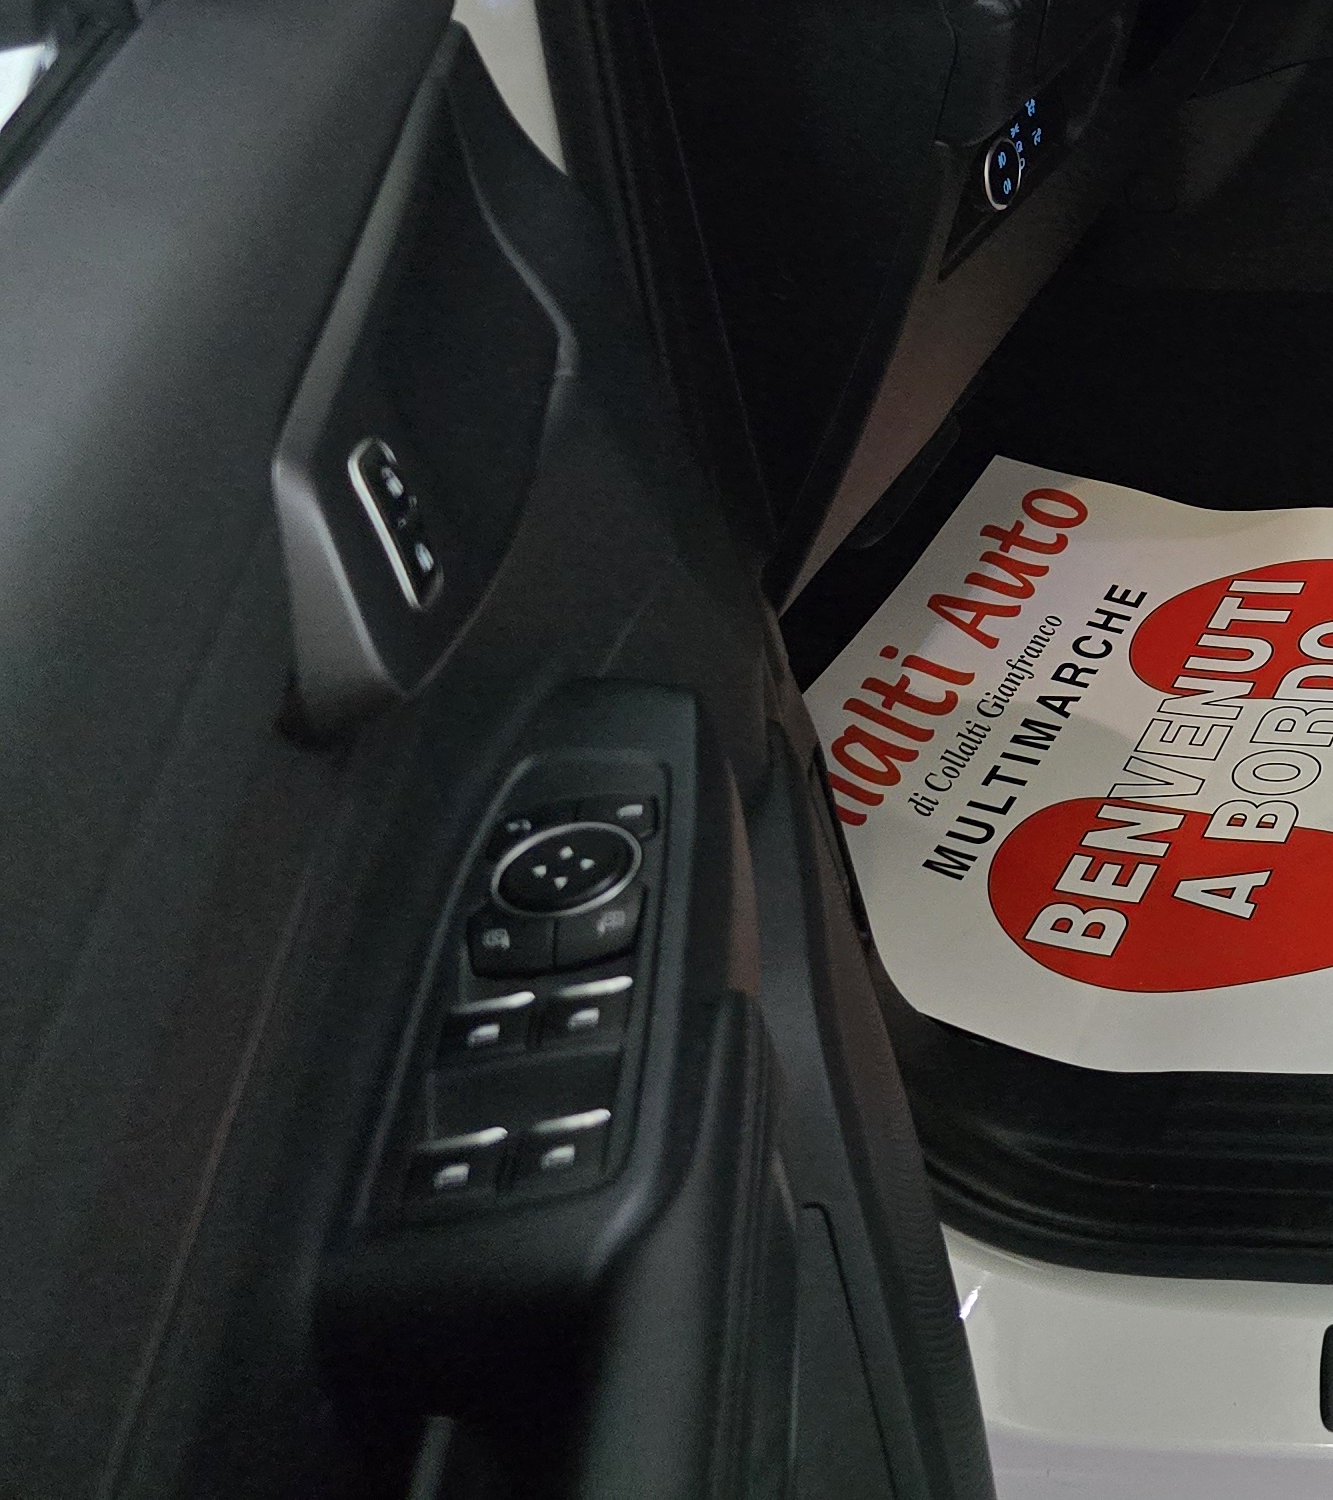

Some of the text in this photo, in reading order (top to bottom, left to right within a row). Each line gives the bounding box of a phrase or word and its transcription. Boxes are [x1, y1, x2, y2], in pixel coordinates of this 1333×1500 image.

[926, 487, 1089, 650] Auto
[907, 615, 1063, 817] di Collalti Gianfranco
[921, 583, 1149, 881] MULTIMARCHE
[1022, 579, 1307, 958] BENVENUTI
[1171, 869, 1274, 920] A
